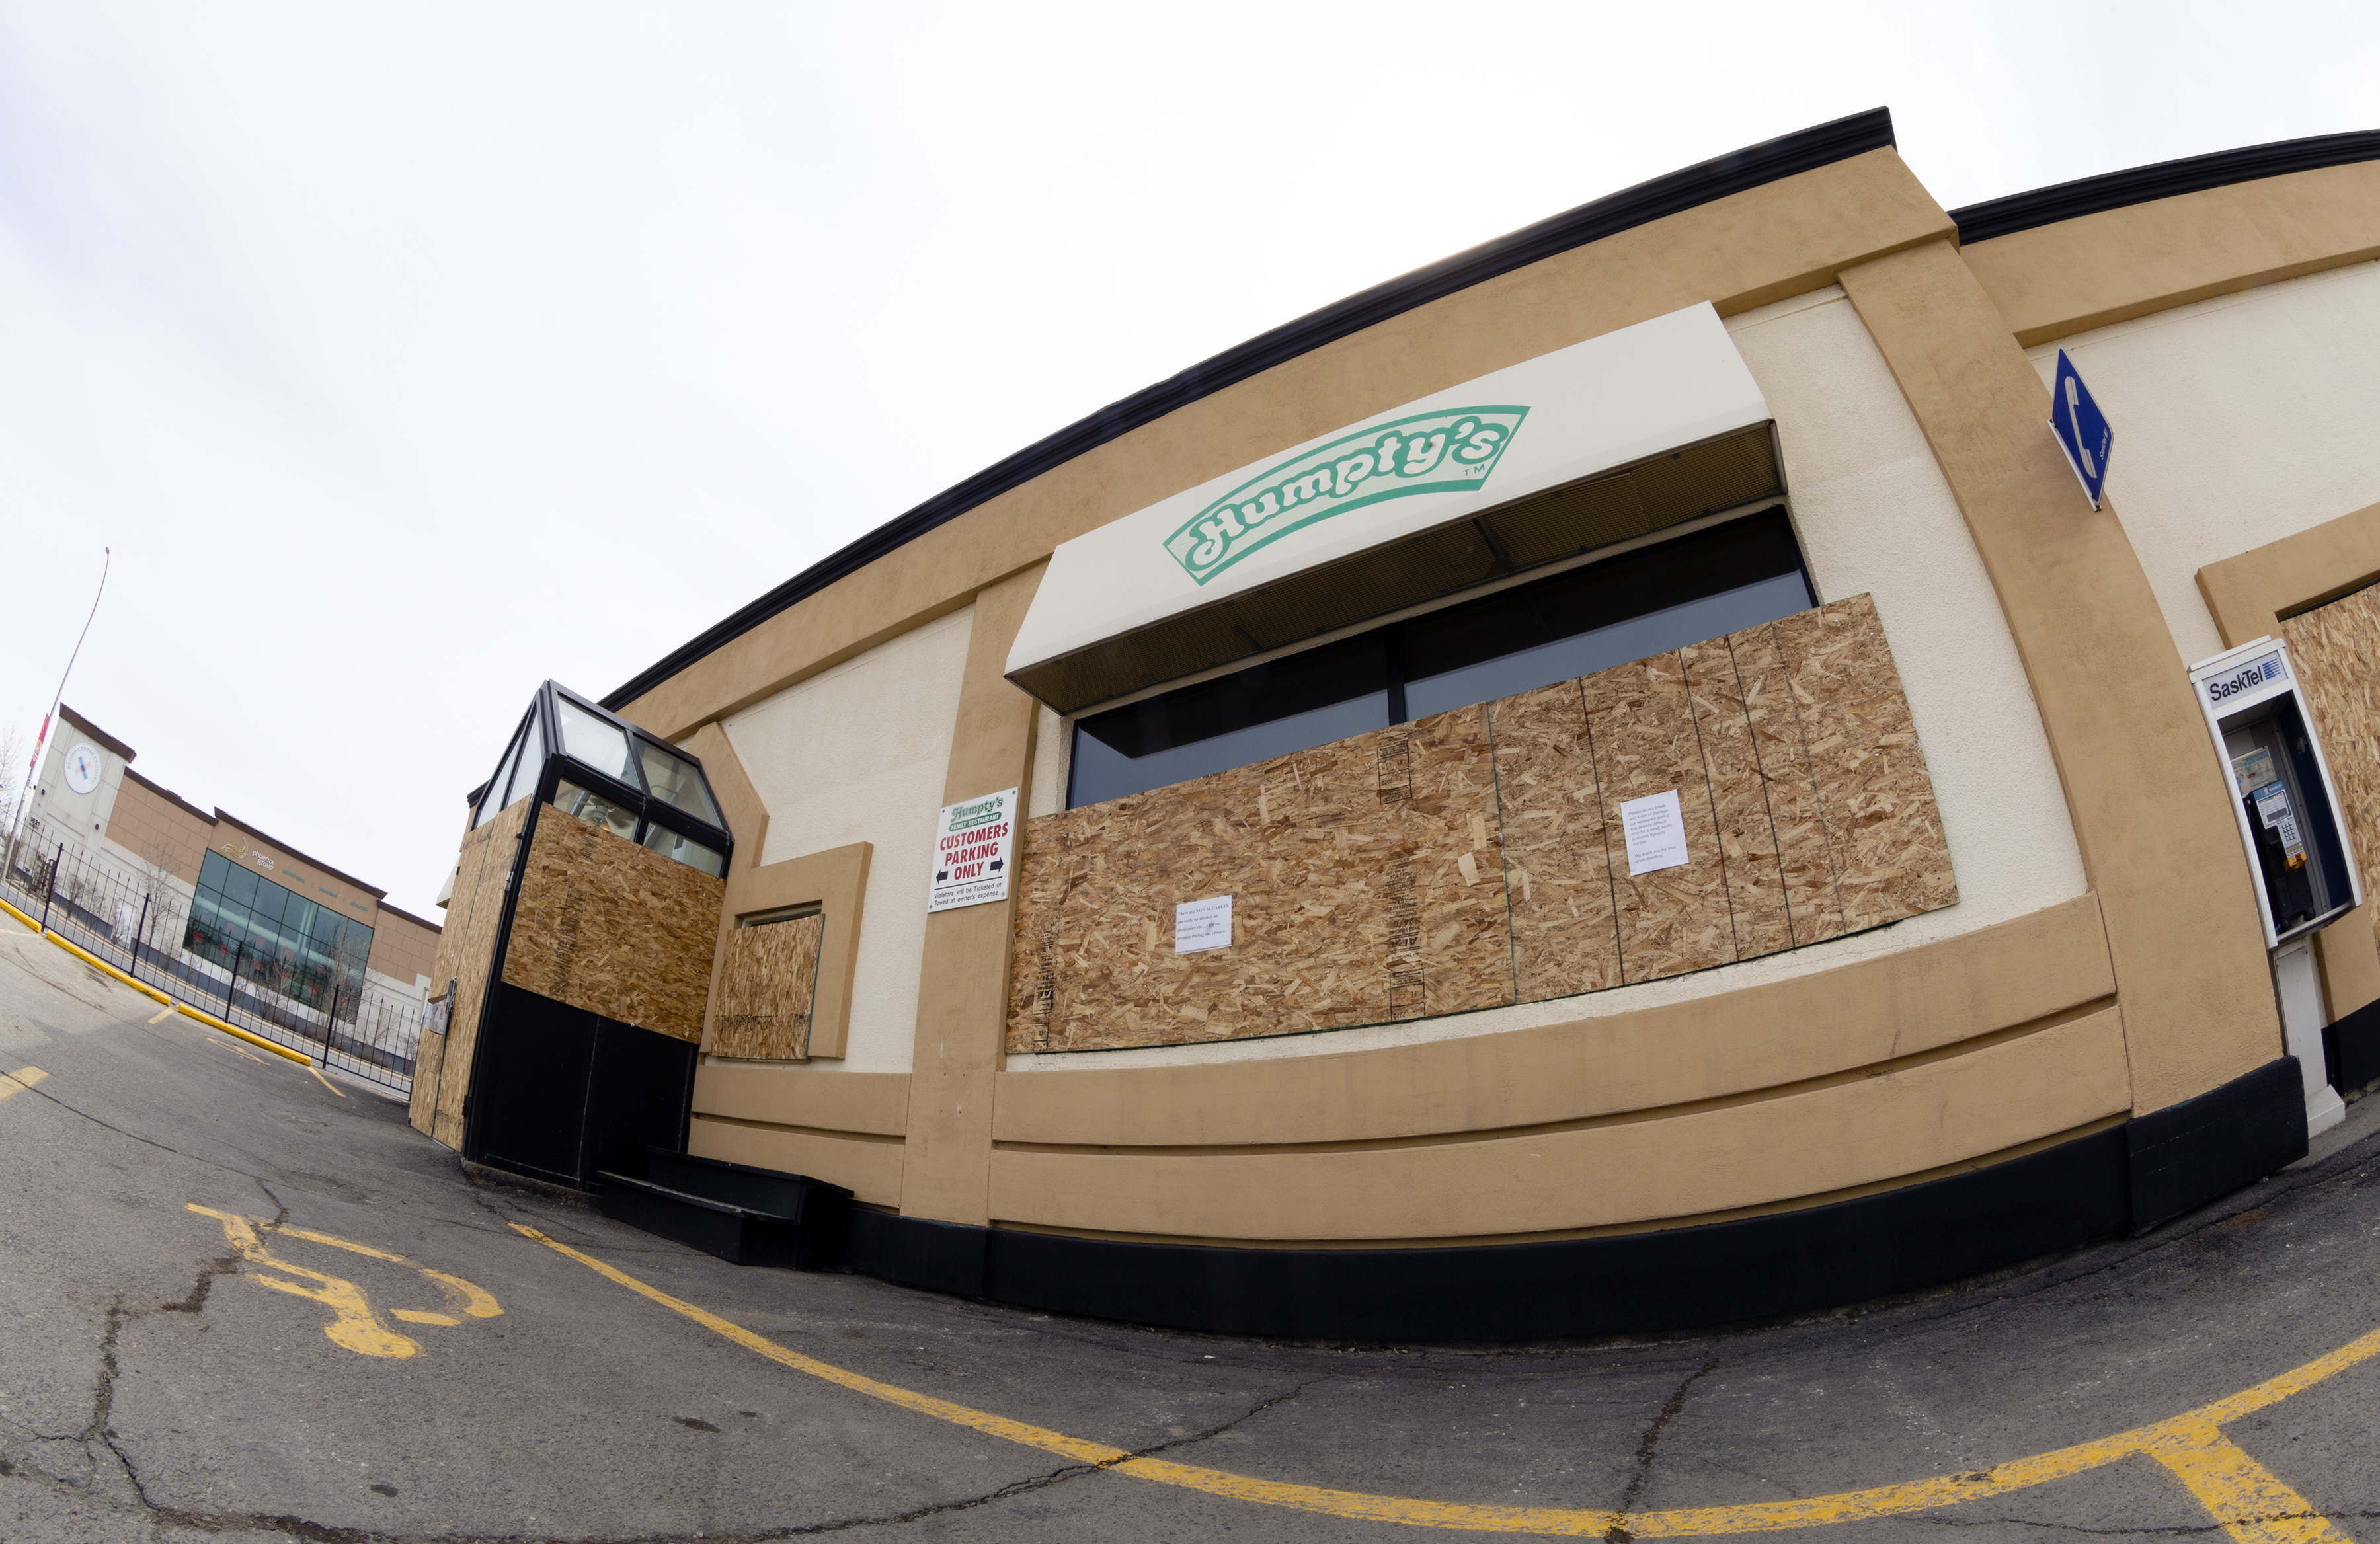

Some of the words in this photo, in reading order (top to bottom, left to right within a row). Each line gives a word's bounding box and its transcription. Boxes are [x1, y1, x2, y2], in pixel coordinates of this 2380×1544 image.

[1462, 463, 1486, 477] TM
[1187, 418, 1507, 570] Humpty's
[2209, 666, 2264, 701] SaskTel
[67, 750, 78, 769] REGINA
[77, 747, 94, 756] CENTRE
[950, 796, 1003, 822] Humpty's
[31, 817, 40, 826] 1621
[951, 822, 967, 831] FAMILY
[969, 813, 1000, 826] RESTAURANT
[940, 822, 1008, 851] CUSTOMERS
[252, 850, 274, 865] phoenix
[945, 841, 998, 866] PARKING
[1636, 854, 1663, 863] understanding.
[257, 859, 274, 870] group
[954, 862, 984, 880] ONLY
[974, 883, 995, 892] Ticketed
[934, 897, 949, 906] Towed
[957, 894, 976, 902] owner's
[978, 890, 1000, 900] expense.
[1393, 918, 1415, 927] 24/0
